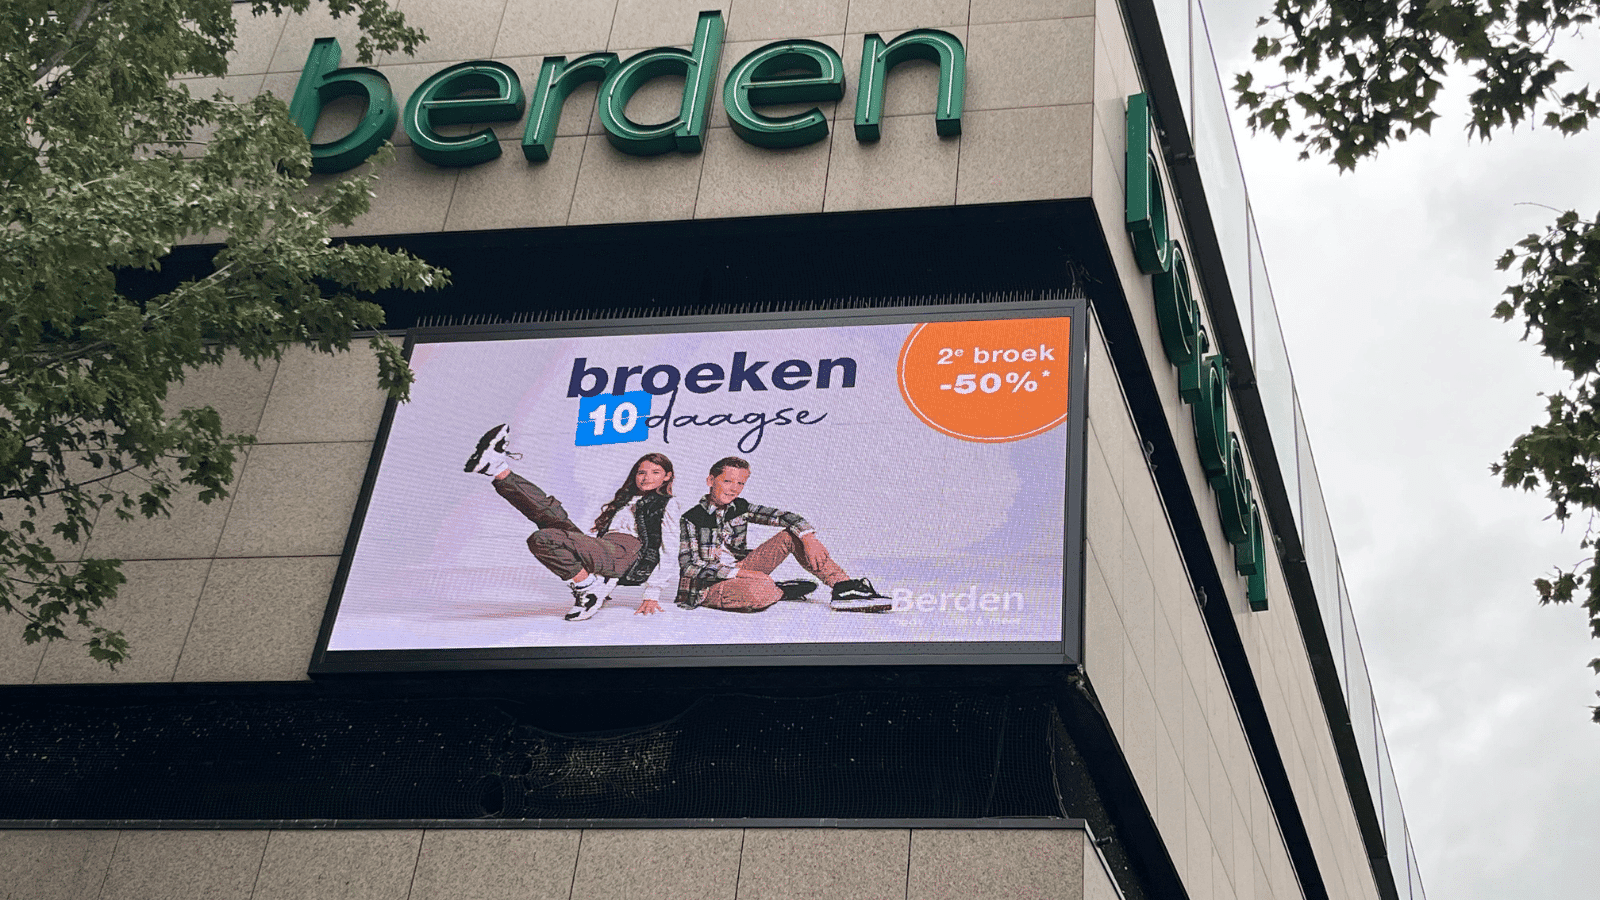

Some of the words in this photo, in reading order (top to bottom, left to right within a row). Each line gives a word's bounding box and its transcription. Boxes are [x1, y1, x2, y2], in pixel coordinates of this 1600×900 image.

[287, 10, 967, 173] berden
[973, 343, 1055, 364] broek
[566, 351, 858, 398] broeken
[891, 585, 1025, 612] Berden
